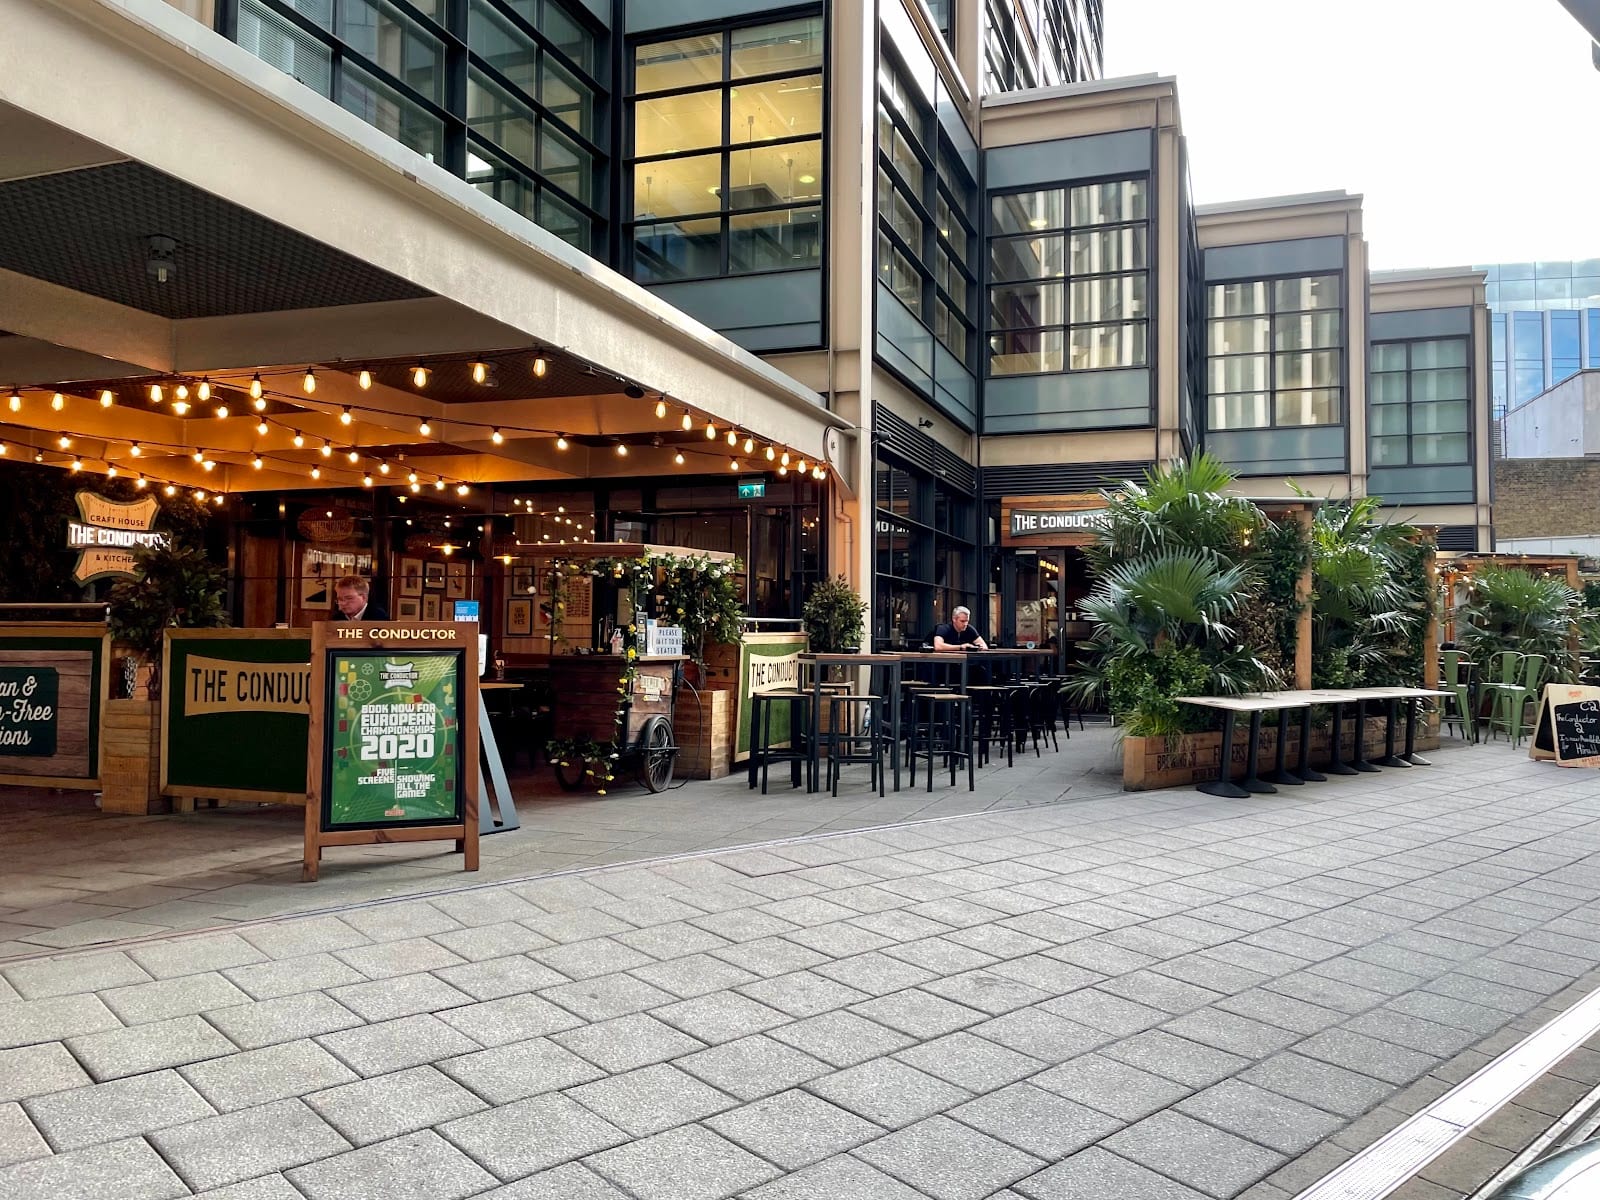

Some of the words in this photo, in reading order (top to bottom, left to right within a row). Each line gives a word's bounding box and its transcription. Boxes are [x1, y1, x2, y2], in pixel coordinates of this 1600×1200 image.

[1014, 514, 1037, 530] THE
[69, 523, 95, 544] THE
[103, 554, 133, 563] KITCHE
[337, 628, 363, 639] THE
[369, 628, 456, 640] CONDUCTOR
[658, 629, 679, 637] PLEASE
[380, 672, 389, 680] THE
[390, 672, 418, 680] CONDUCTOR
[751, 663, 766, 687] THE
[768, 659, 798, 684] CONDUCT
[22, 675, 38, 697] &
[192, 668, 228, 702] THE
[361, 704, 389, 714] BOOK
[391, 703, 415, 713] NOW
[417, 703, 436, 713] FOR
[361, 712, 436, 727] EUROPEAN
[0, 725, 32, 746] ions
[361, 725, 436, 736] CHAMPIONSHIPS
[360, 733, 435, 761] 2020
[376, 768, 395, 777] FIVE
[397, 773, 436, 783] SHOWING
[357, 775, 395, 785] SCREENS
[397, 782, 412, 790] ALL
[414, 781, 431, 790] THE
[397, 789, 426, 799] GAMES
